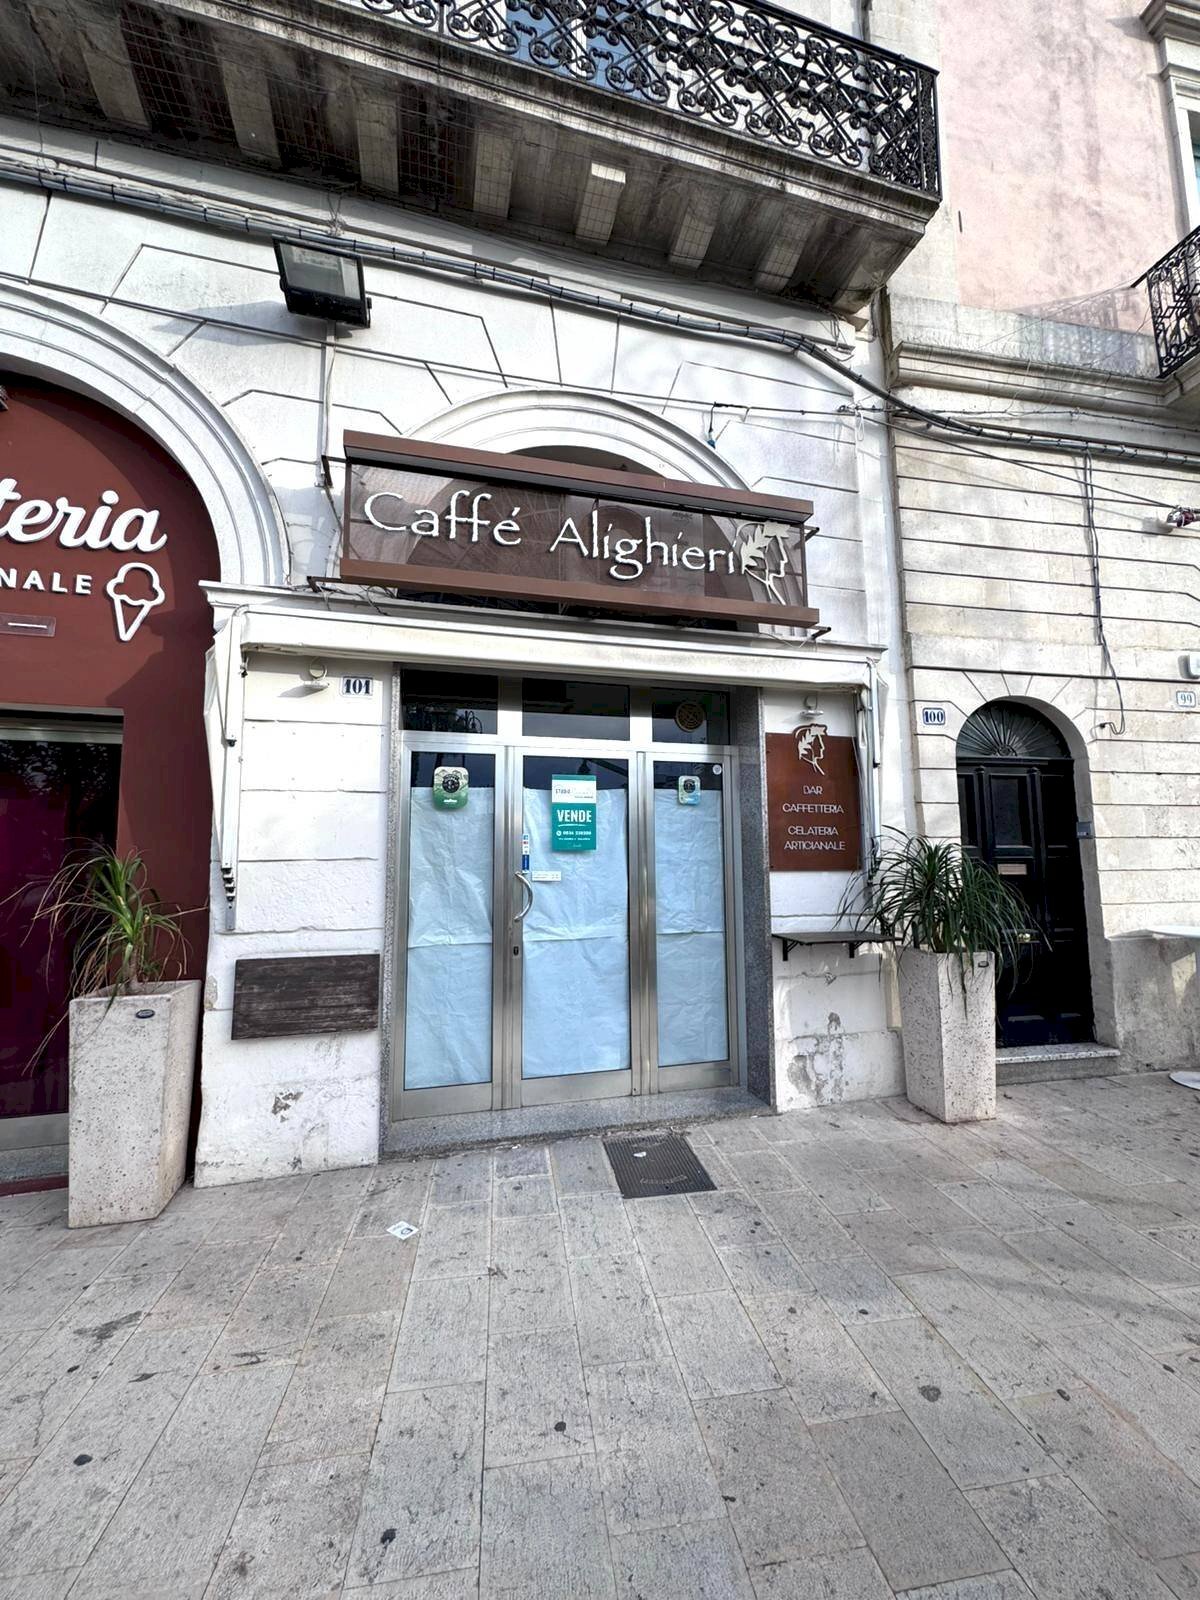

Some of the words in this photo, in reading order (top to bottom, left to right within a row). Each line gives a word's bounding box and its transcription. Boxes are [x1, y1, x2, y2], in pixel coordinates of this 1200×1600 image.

[364, 489, 521, 545] Caffé
[550, 510, 736, 580] Alighieri
[0, 567, 93, 595] NALE
[344, 678, 370, 695] 101
[1180, 693, 1193, 704] 99
[924, 710, 944, 723] 100
[782, 802, 844, 814] CAFFETTERIA
[556, 809, 592, 823] VENDE
